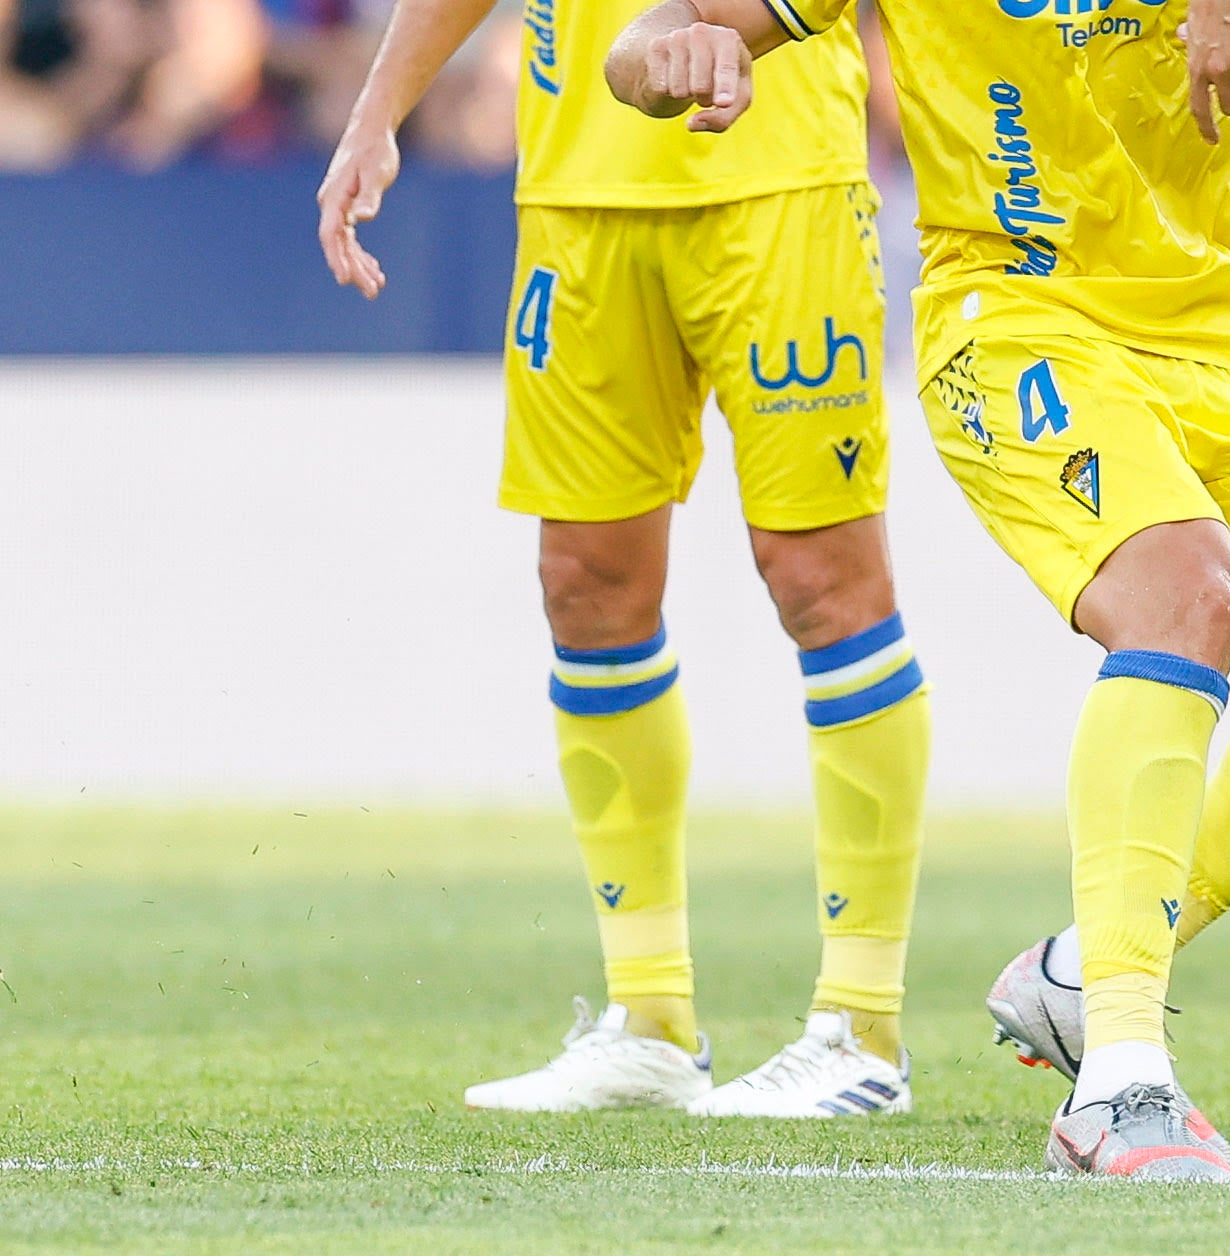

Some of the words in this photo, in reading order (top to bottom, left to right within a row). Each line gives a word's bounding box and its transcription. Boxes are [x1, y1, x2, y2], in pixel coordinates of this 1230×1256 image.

[988, 76, 1066, 236] Turismo
[515, 268, 556, 370] 4
[750, 316, 867, 390] wh
[1017, 357, 1070, 443] 4
